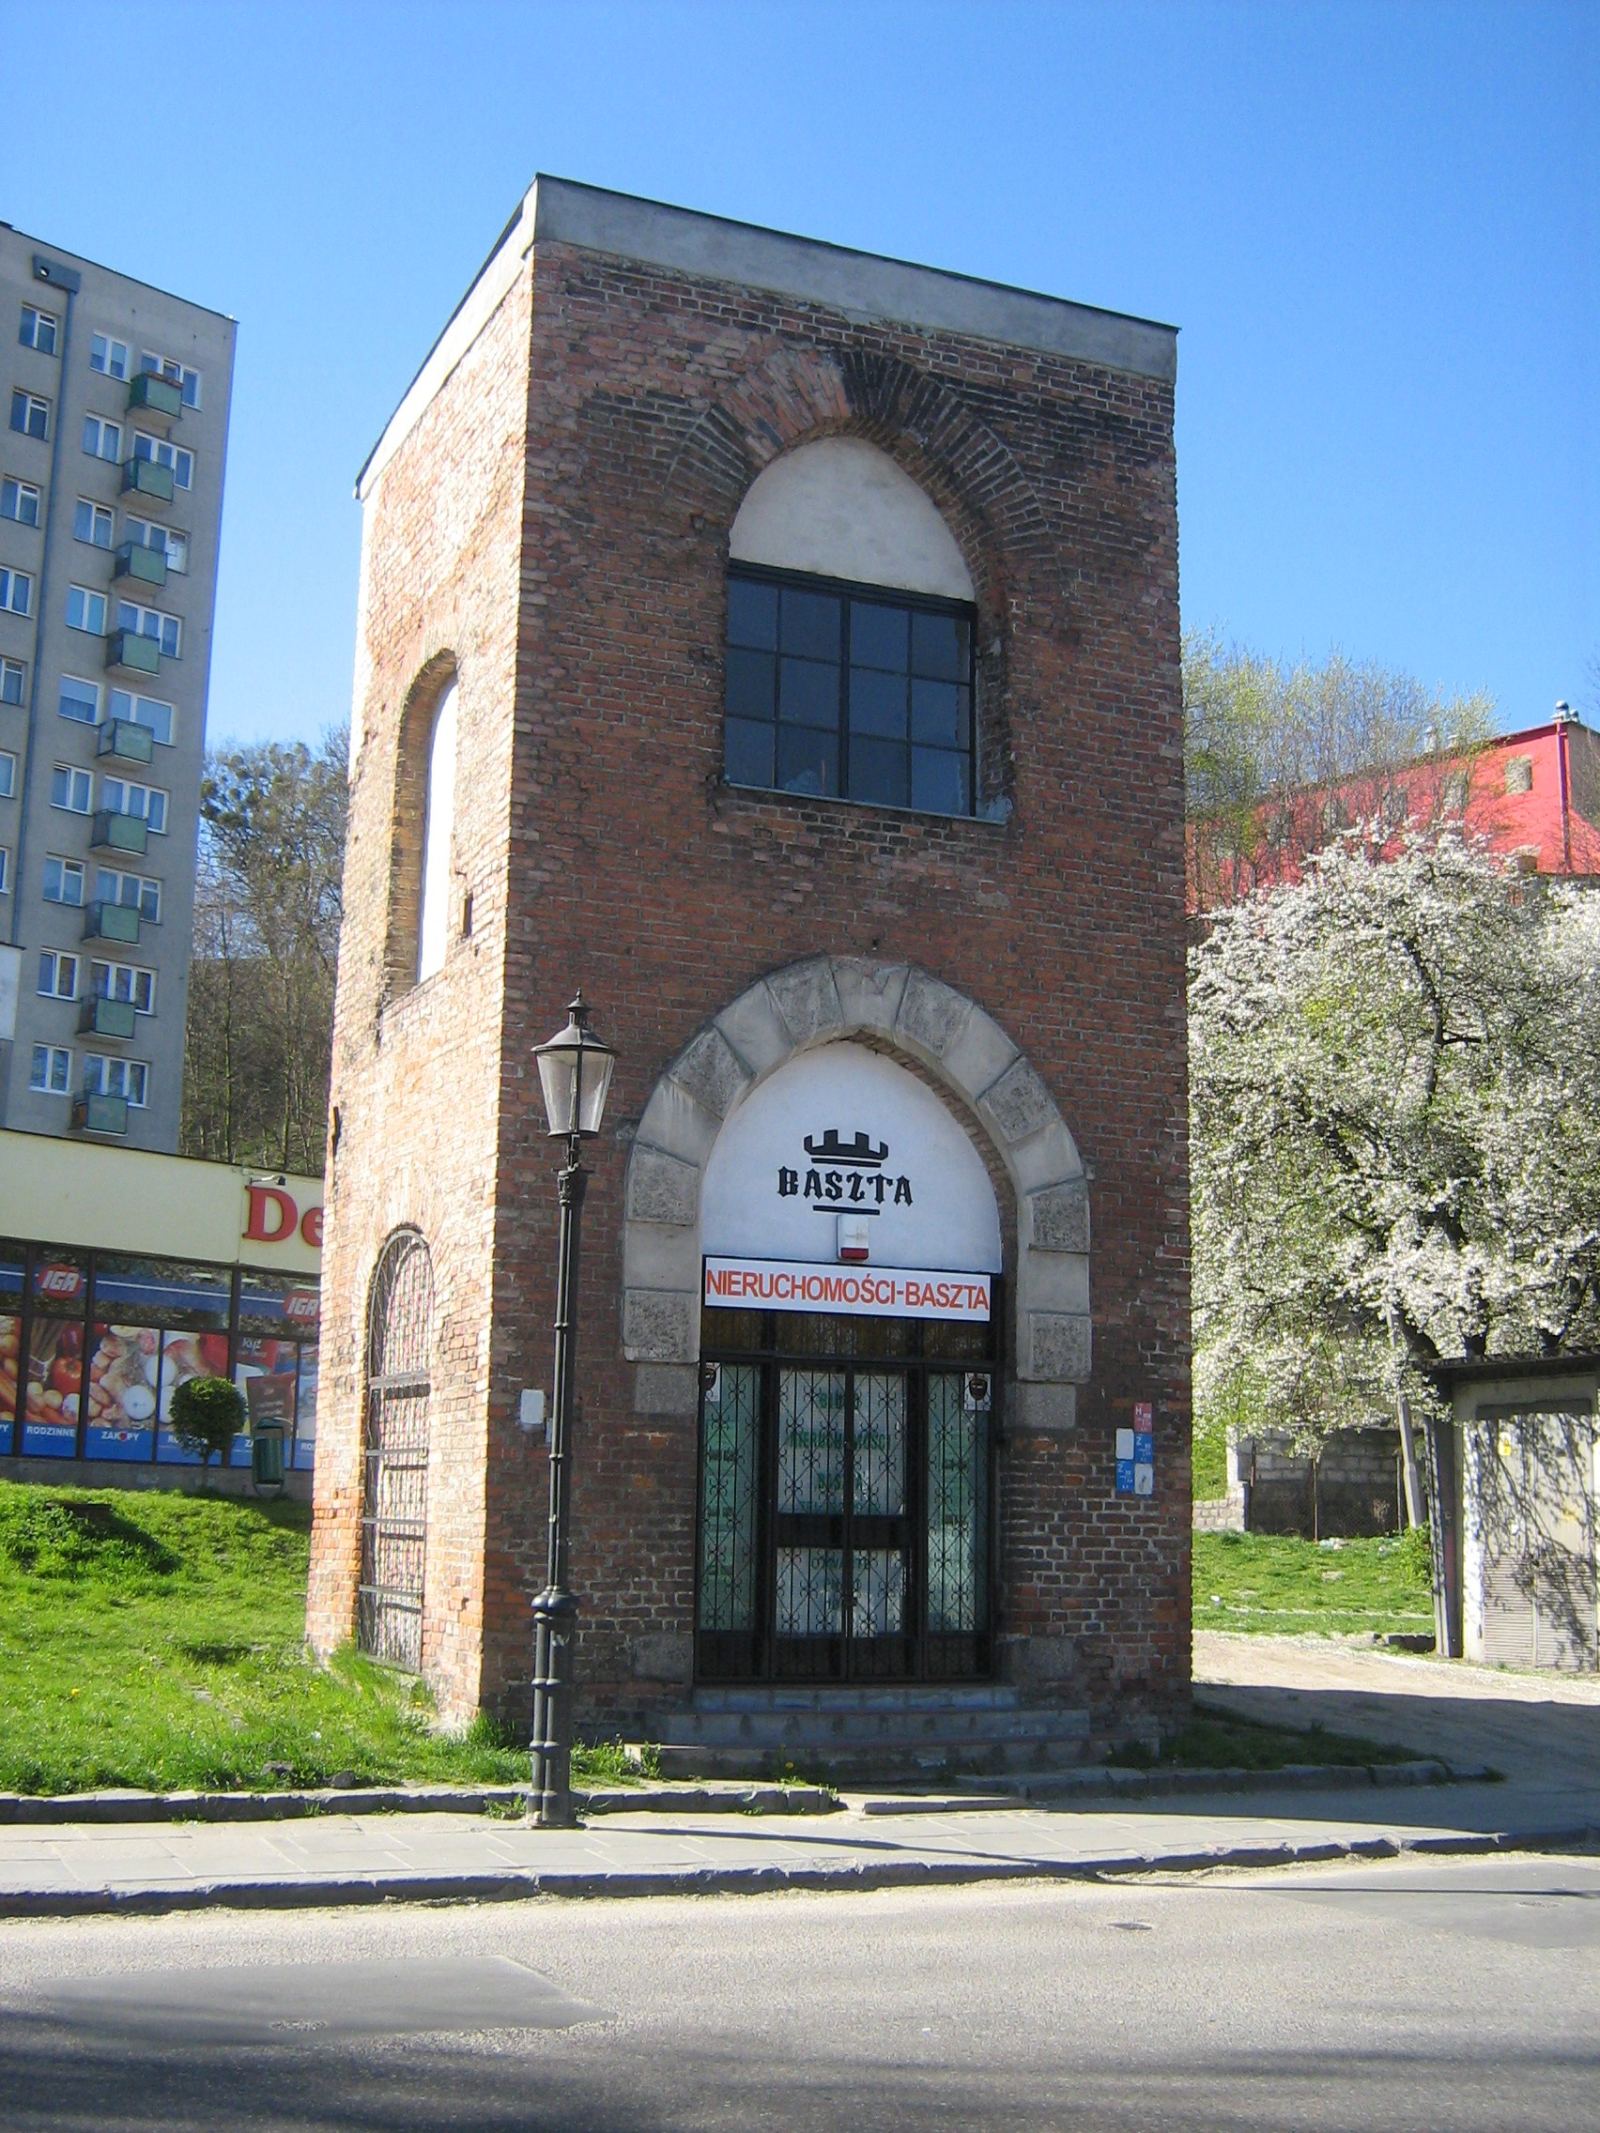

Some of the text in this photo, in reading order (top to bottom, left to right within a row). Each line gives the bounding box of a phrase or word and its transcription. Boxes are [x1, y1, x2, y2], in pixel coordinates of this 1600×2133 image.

[777, 1165, 914, 1207] BASZTA
[41, 1269, 81, 1292] IGA
[706, 1269, 990, 1311] NIERUCHOMOŚCI-BASZTA
[287, 1296, 320, 1317] IGA
[26, 1425, 76, 1438] RODZINNE
